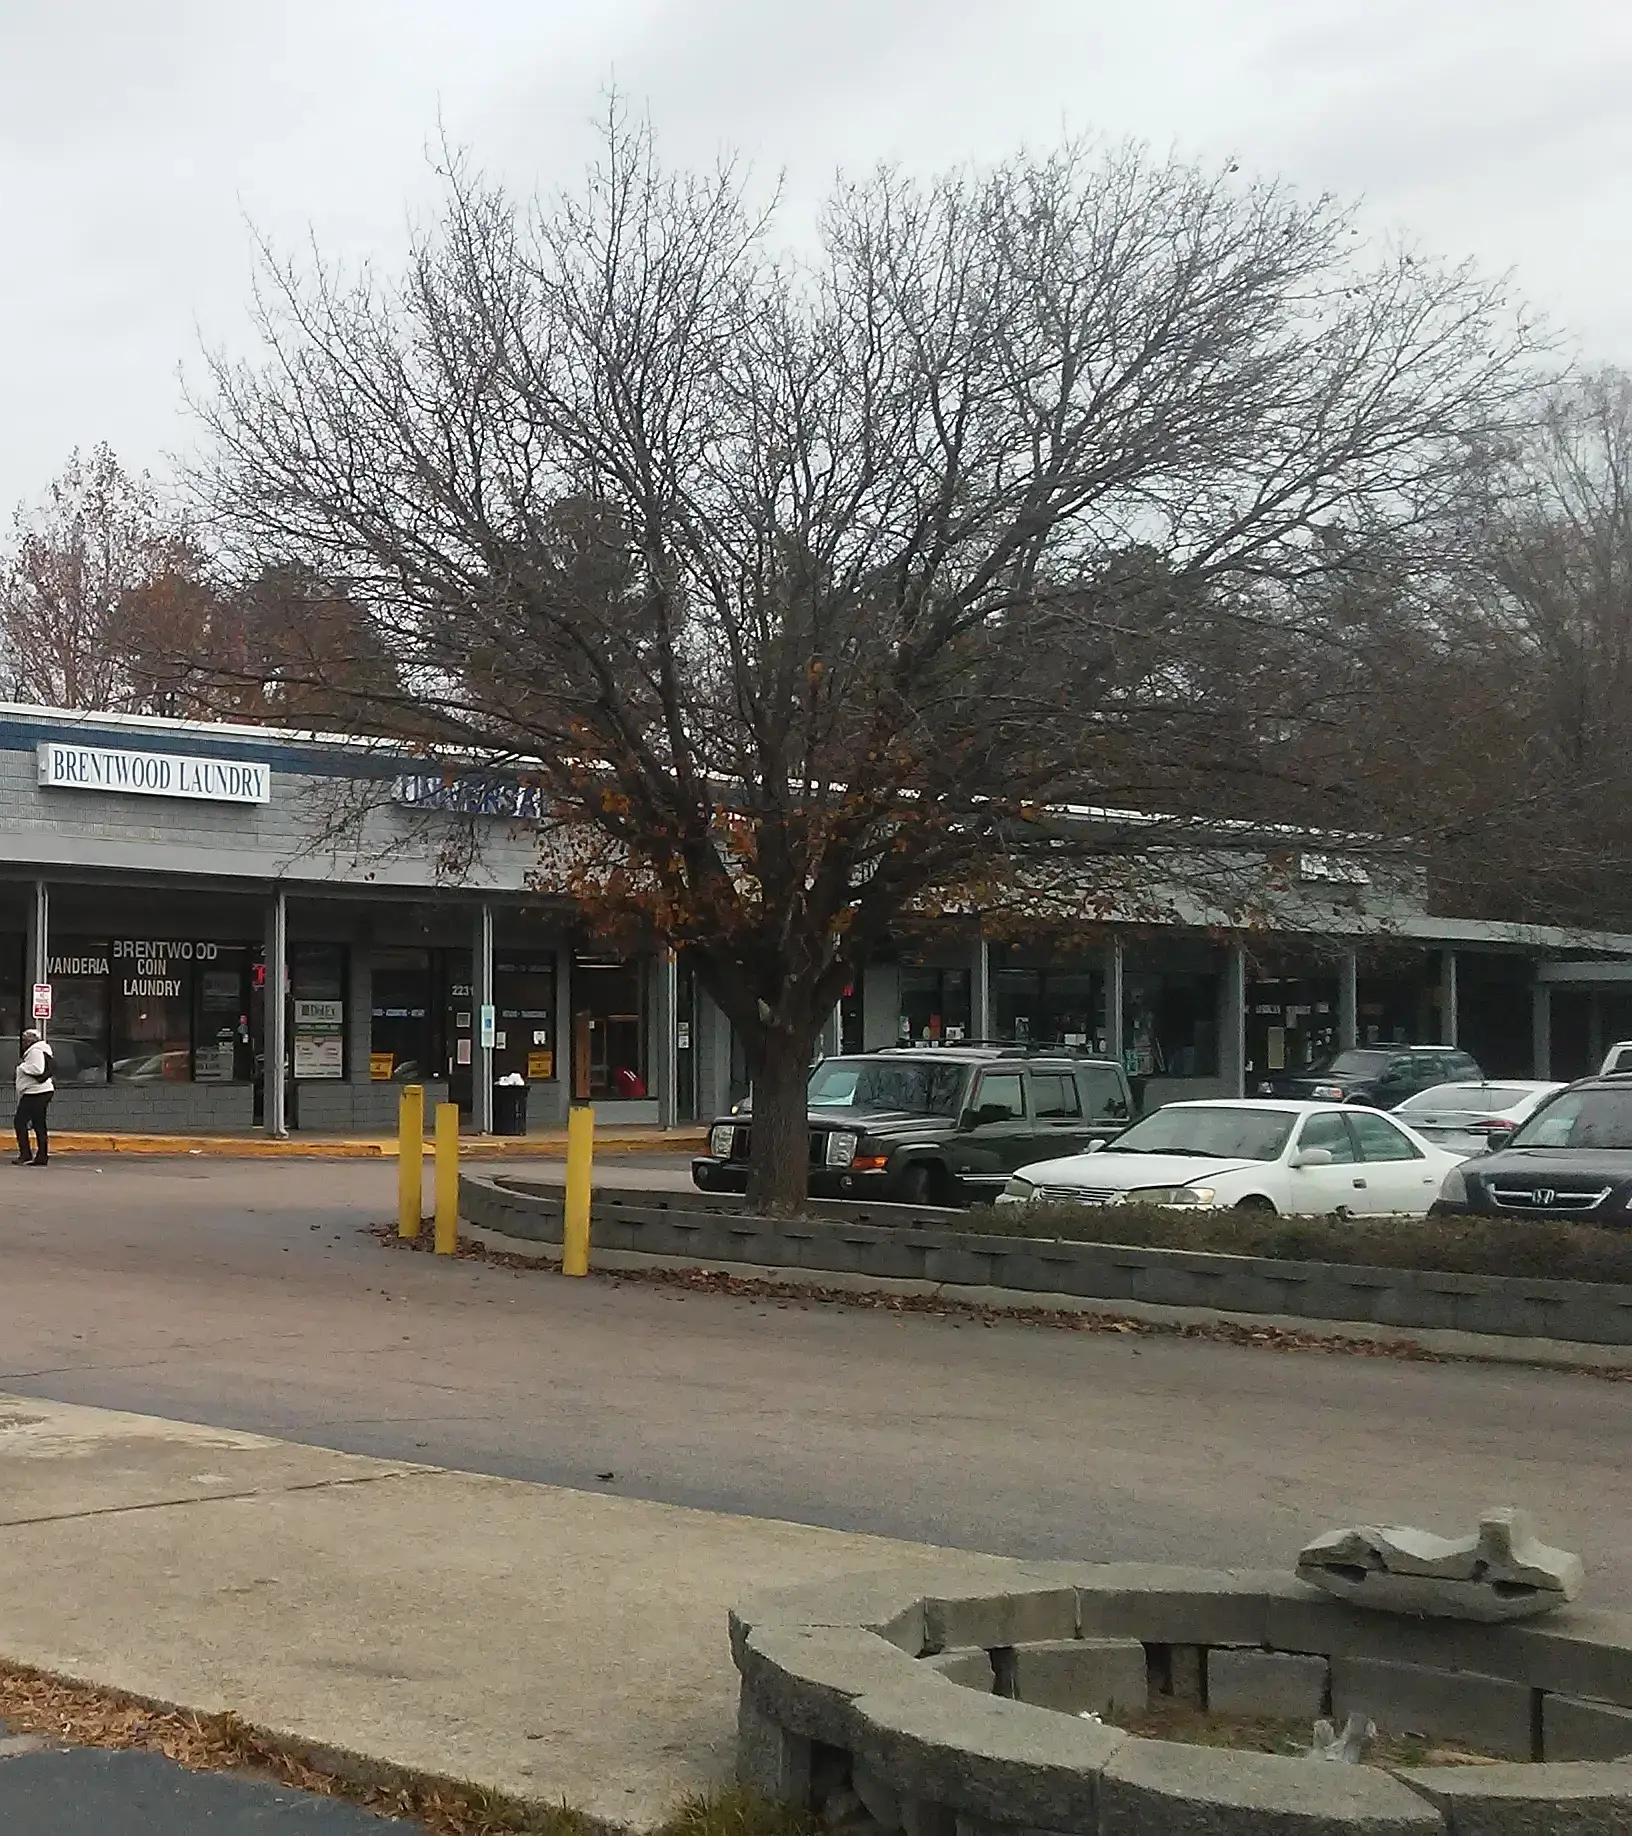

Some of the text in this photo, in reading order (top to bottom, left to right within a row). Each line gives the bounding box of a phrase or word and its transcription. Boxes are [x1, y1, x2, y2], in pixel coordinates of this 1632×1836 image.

[53, 750, 266, 798] BRENTWOOD LAUNDRY
[47, 957, 109, 974] VANDERIA
[137, 959, 166, 976] COIN
[123, 979, 181, 997] LAUNDRY
